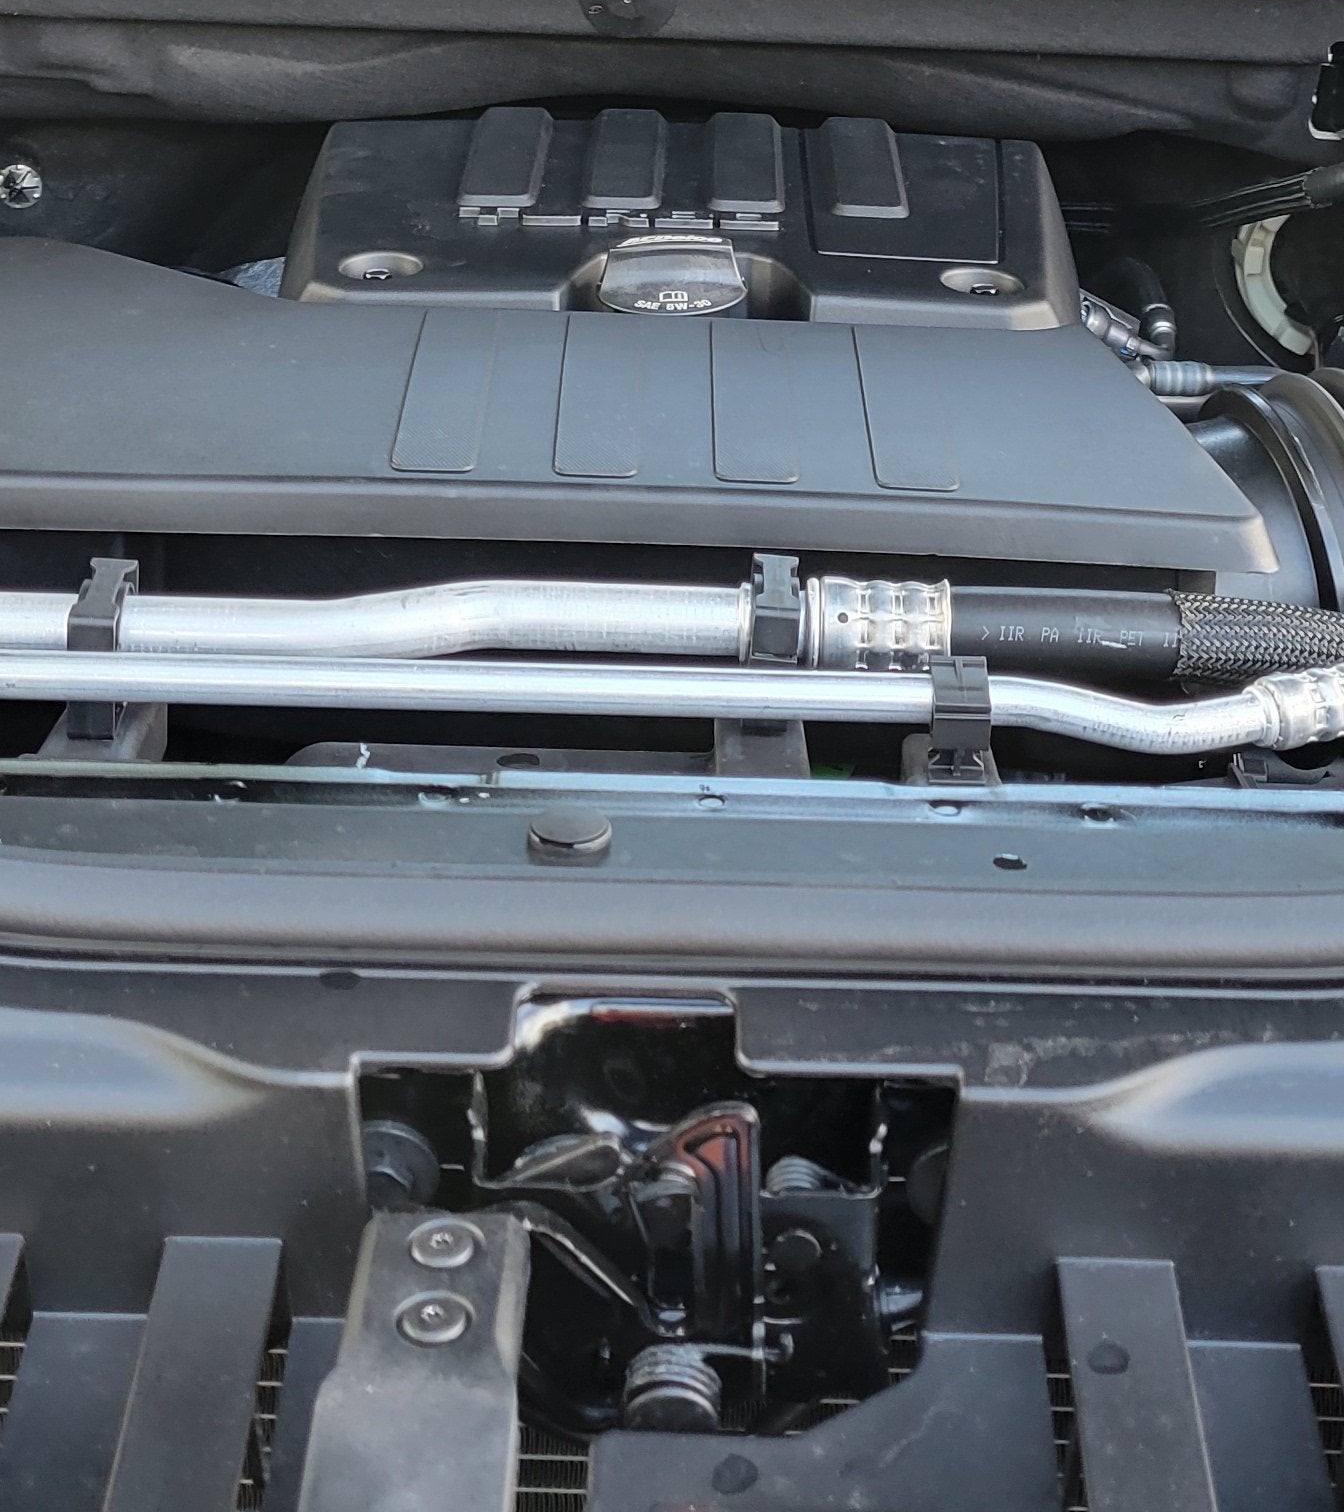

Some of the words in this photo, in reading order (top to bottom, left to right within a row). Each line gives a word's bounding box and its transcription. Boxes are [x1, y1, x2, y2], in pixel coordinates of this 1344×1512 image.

[634, 300, 661, 311] SAE
[666, 300, 712, 311] 5W-30
[1040, 626, 1060, 643] PA
